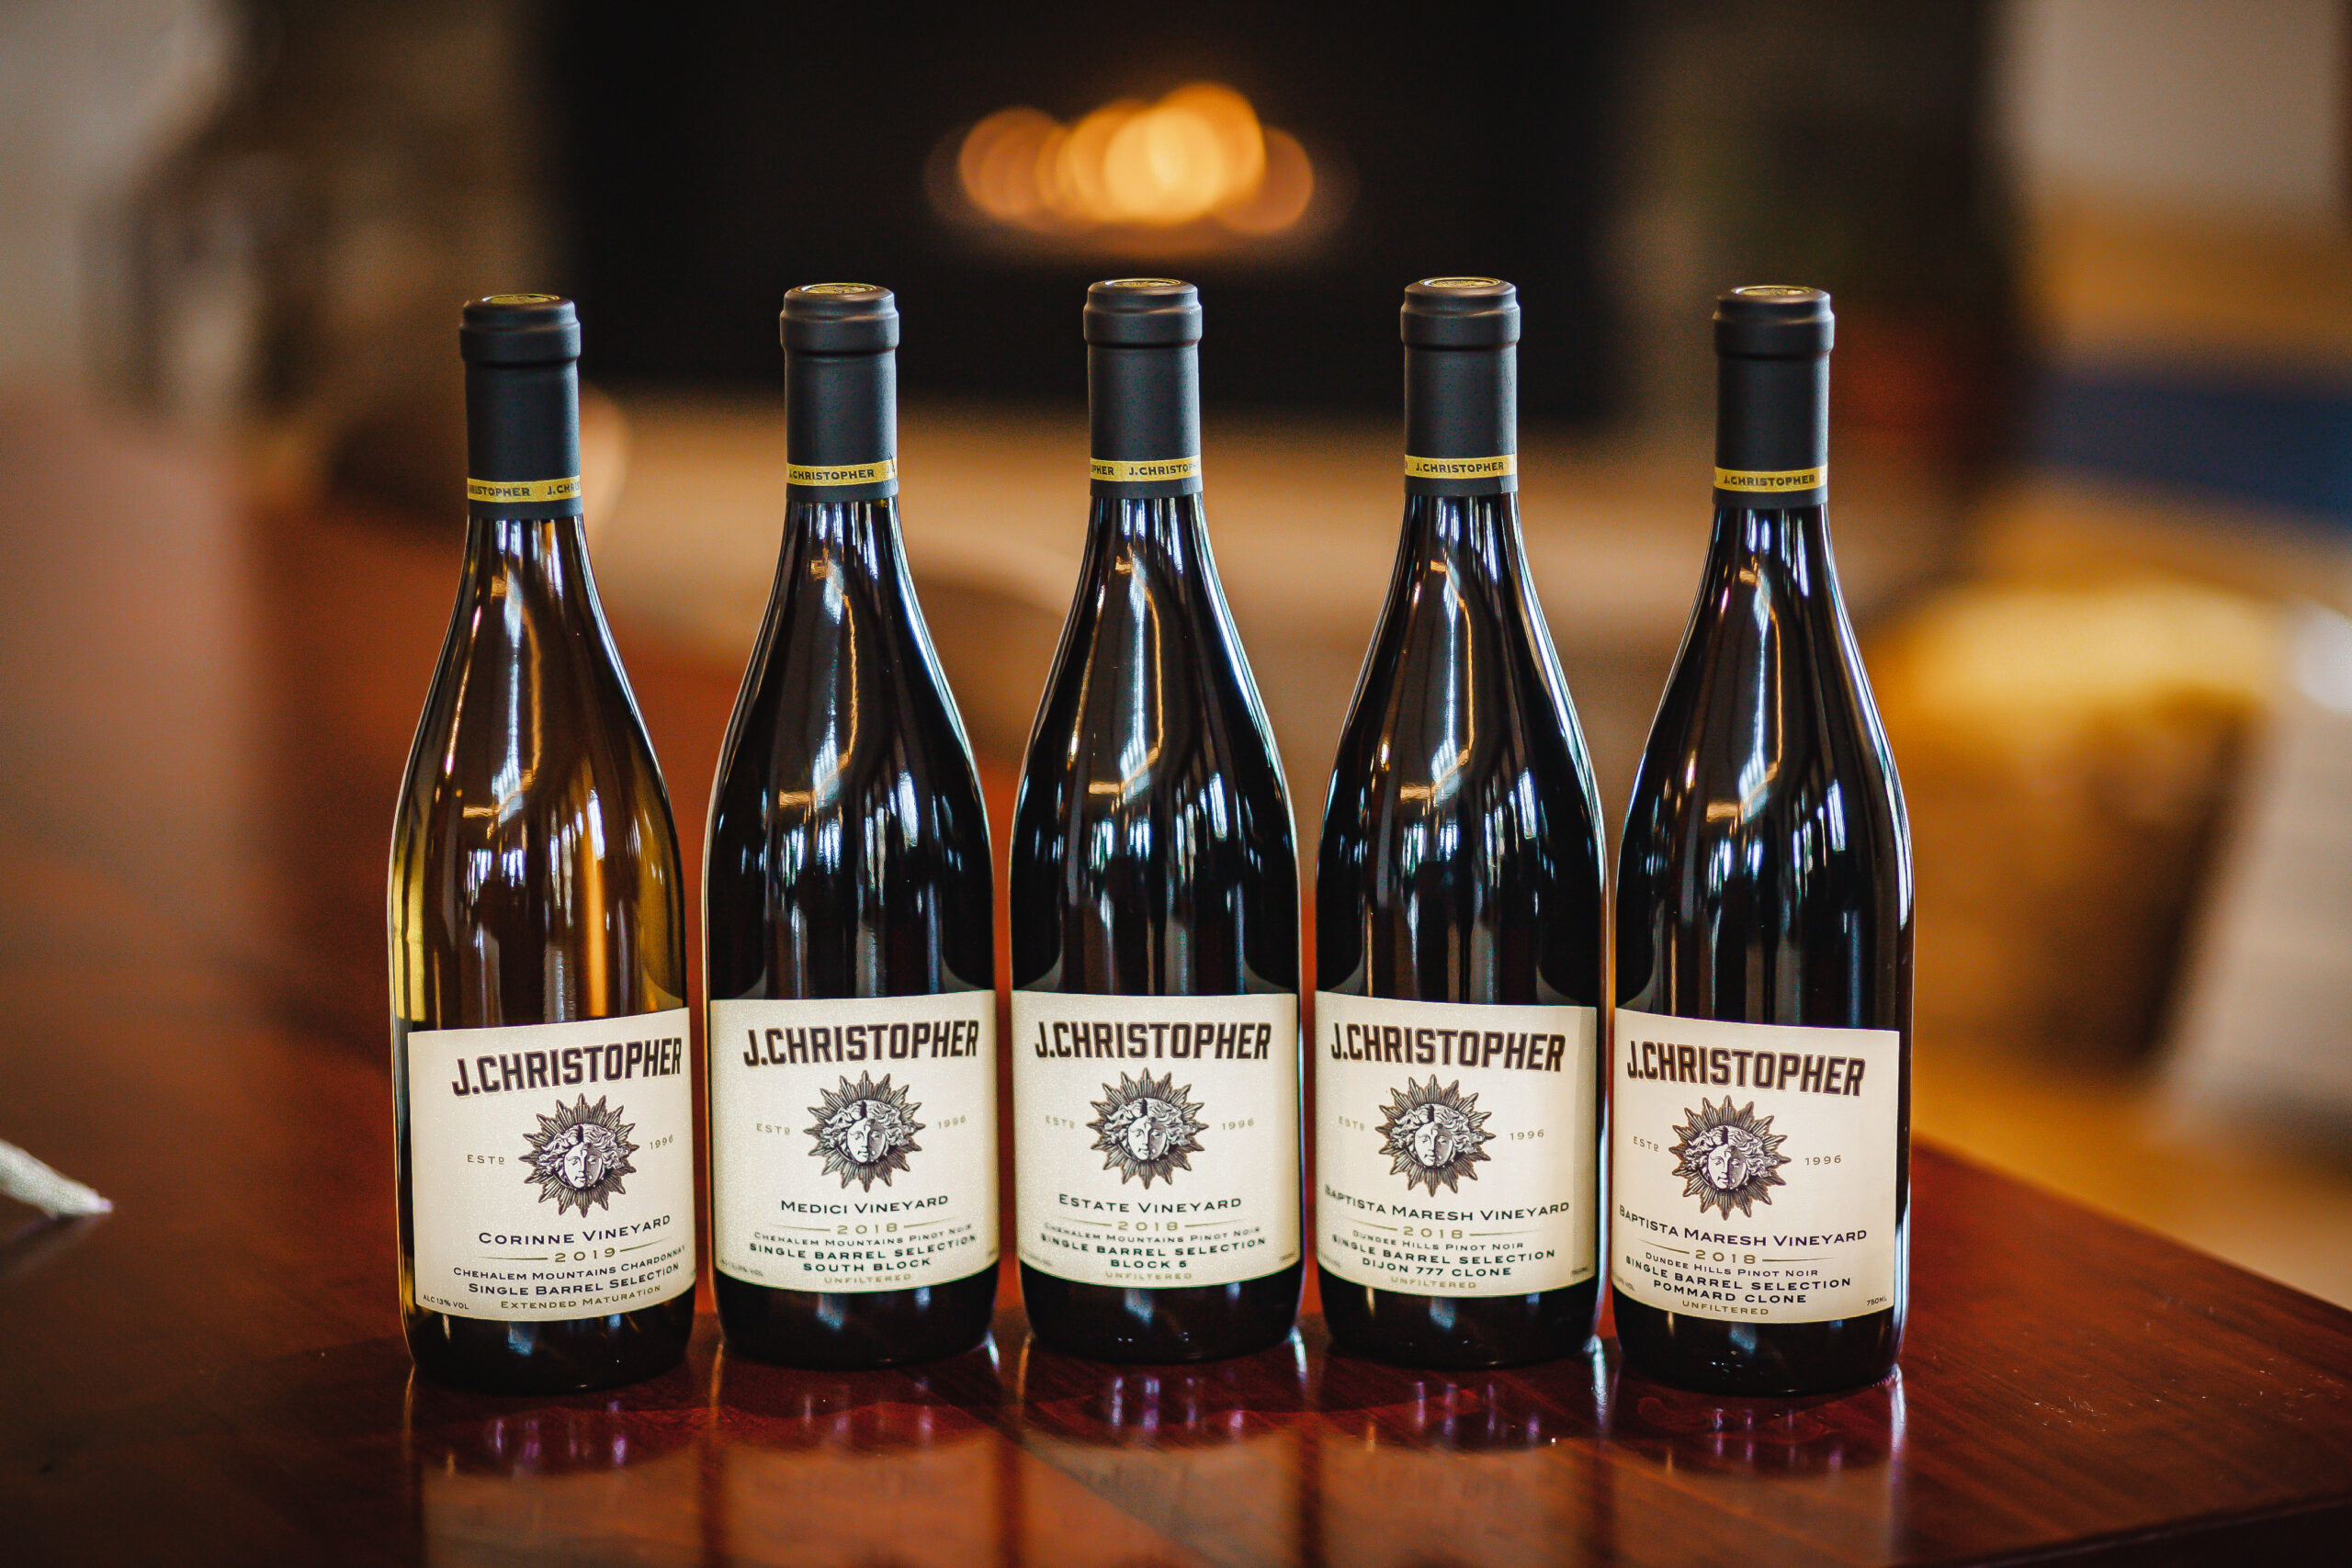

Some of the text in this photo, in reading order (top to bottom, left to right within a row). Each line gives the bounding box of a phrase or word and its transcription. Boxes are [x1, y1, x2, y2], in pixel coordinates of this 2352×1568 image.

[1416, 462, 1504, 473] J.CHRISTOPHER
[1724, 475, 1815, 486] J.CHRISTOPHER
[743, 1020, 978, 1066] J.CHRISTOPHER
[1035, 1021, 1271, 1060] J.CHRISTOPHER
[1331, 1022, 1566, 1072] J.CHRISTOPHER
[451, 1037, 682, 1097] J.CHRISTOPHER
[1627, 1040, 1865, 1096] J.CHRISTOPHER
[650, 1134, 674, 1149] 1996
[1510, 1129, 1544, 1141] 1996
[1804, 1155, 1841, 1166] 1996
[837, 1224, 898, 1235] 2018
[1118, 1221, 1178, 1232] 2018
[1403, 1226, 1463, 1239] 2018
[750, 1243, 806, 1258] SINGLE
[815, 1251, 886, 1259] BARREL
[894, 1235, 976, 1258] SELECTION
[1041, 1233, 1266, 1257] SINGLE BARREL SELECTION
[554, 1247, 616, 1263] 2019
[1384, 1249, 1450, 1265] BARREL
[1459, 1249, 1555, 1265] SELECTION
[1695, 1249, 1756, 1264] 2018
[803, 1258, 931, 1272] SOUTH BLOCK
[1111, 1259, 1170, 1269] BLOCK
[1363, 1258, 1511, 1277] DIJON 777 CLONE
[824, 1273, 911, 1284] UNFILTERED
[1105, 1270, 1192, 1280] UNFILTERED
[1626, 1256, 1851, 1291] SINGLE BARREL SELECTION
[1391, 1276, 1476, 1288] UNFILTERED
[424, 1294, 435, 1303] ALC
[1654, 1280, 1806, 1303] POMMARD CLONE
[1682, 1300, 1770, 1315] UNFILTERED
